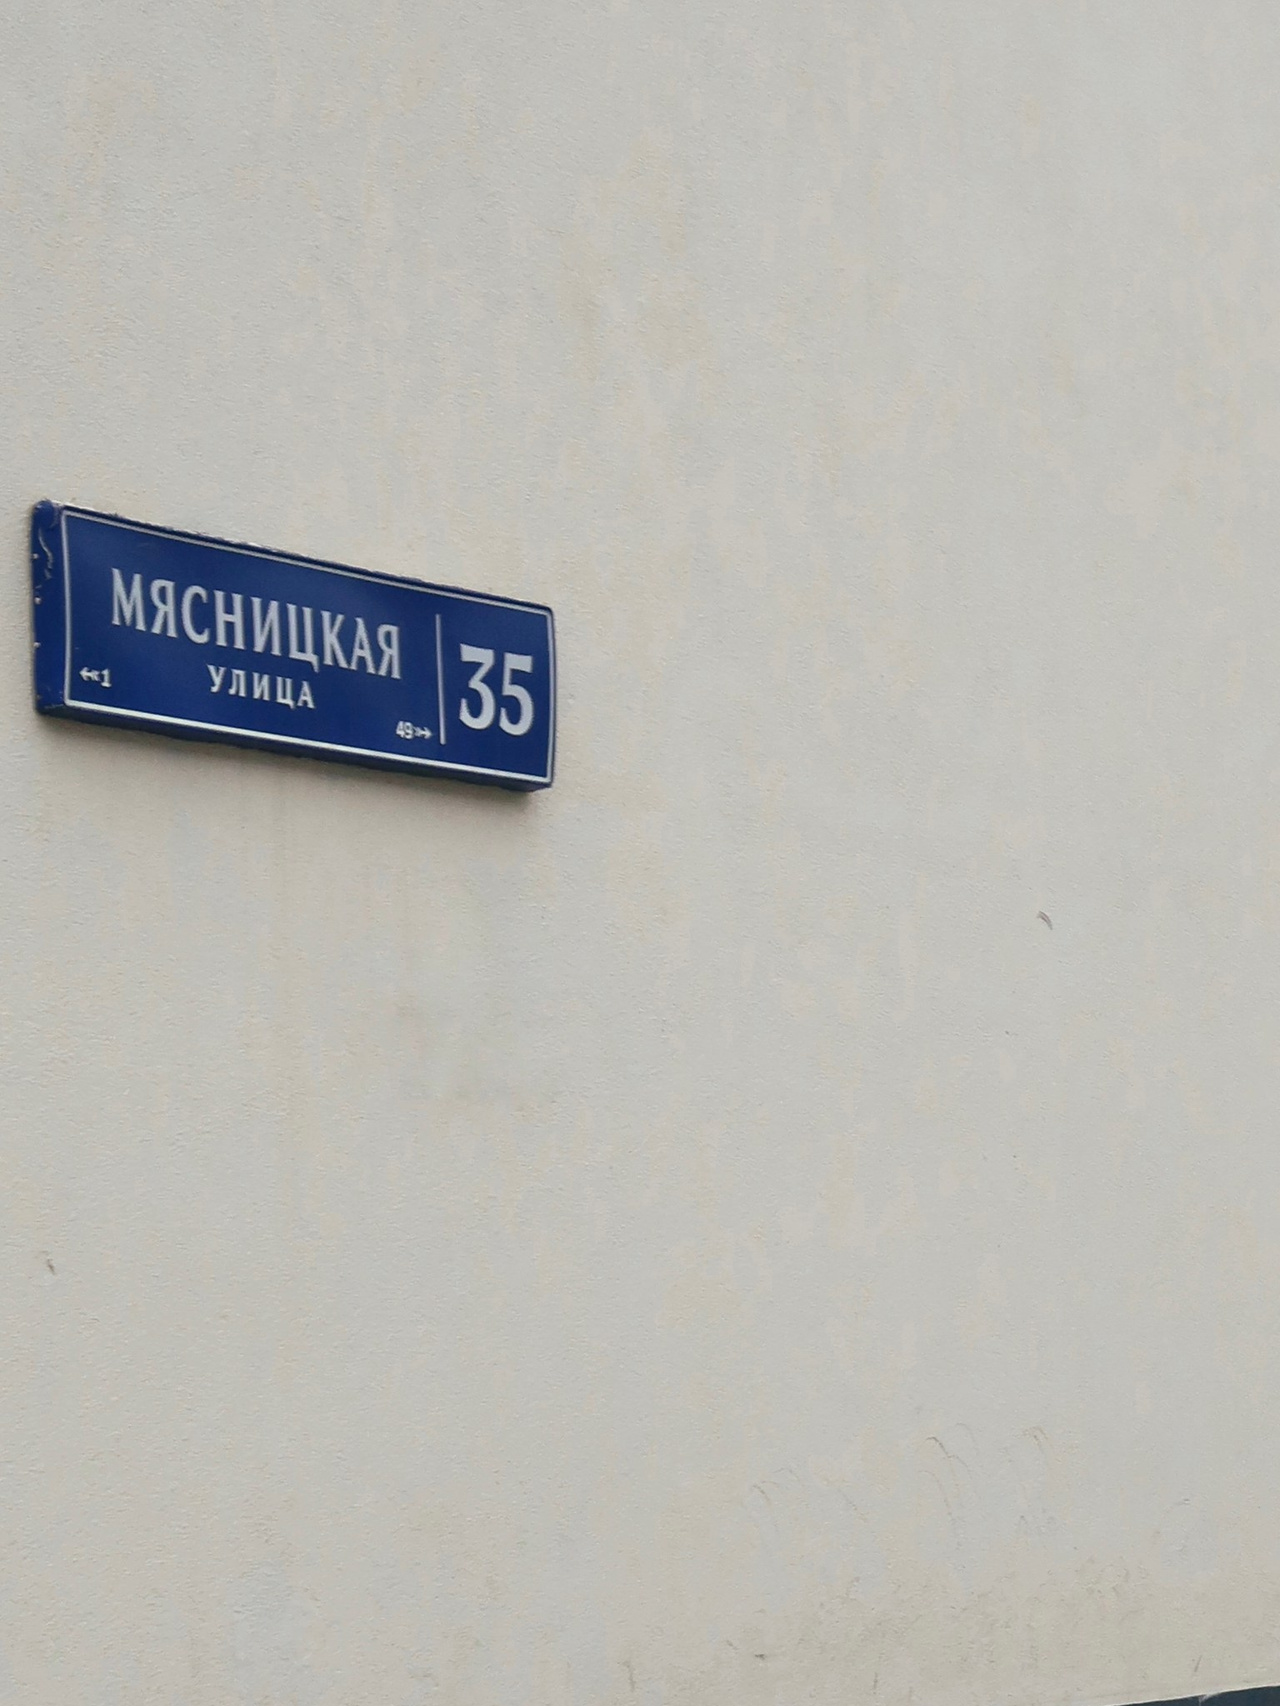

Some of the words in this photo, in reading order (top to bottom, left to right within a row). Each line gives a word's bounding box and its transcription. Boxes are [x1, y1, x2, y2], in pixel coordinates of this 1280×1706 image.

[111, 567, 402, 680] МЯСНИЦКАЯ
[100, 668, 112, 688] 1
[206, 663, 316, 710] УЛИЦА
[458, 642, 535, 737] 35
[395, 720, 415, 740] 49
